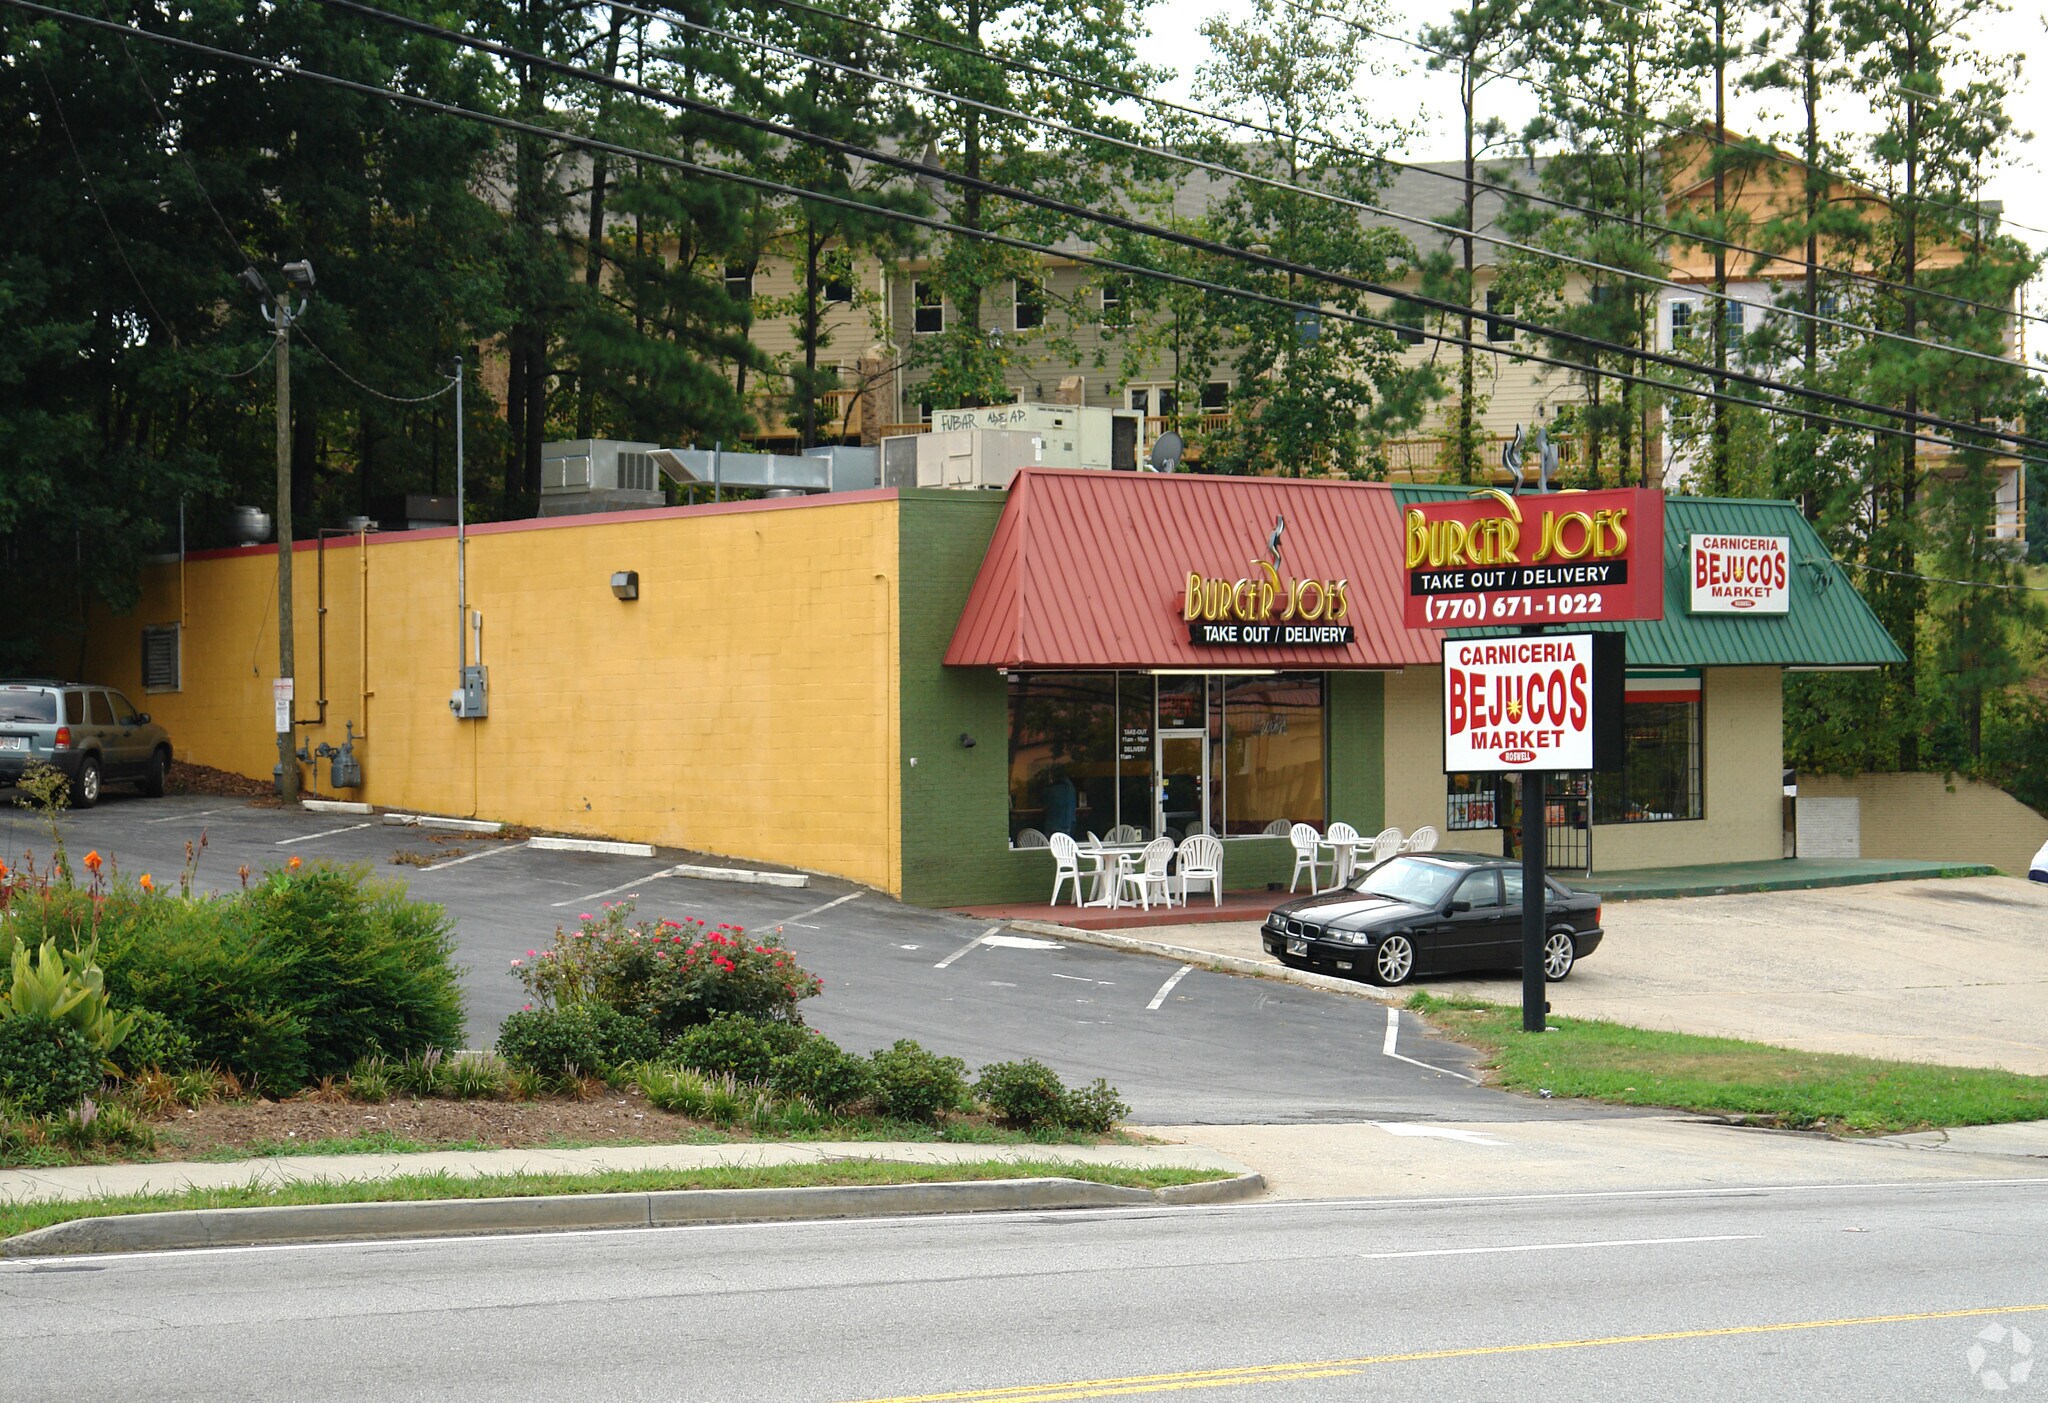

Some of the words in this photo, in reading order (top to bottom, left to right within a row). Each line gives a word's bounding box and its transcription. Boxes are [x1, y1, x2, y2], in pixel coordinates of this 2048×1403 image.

[941, 414, 978, 431] FUBAR
[1703, 537, 1778, 550] CARNICERIA
[1422, 574, 1464, 590] TAKE
[1471, 572, 1506, 587] OUT
[1512, 570, 1517, 585] /
[1523, 566, 1610, 585] DELIVERY
[1696, 549, 1785, 590] BEJUCOS
[1712, 587, 1772, 597] MARKET
[1425, 593, 1486, 622] (770)
[1492, 593, 1602, 616] 671-1022
[1204, 626, 1237, 642] TAKE
[1243, 626, 1270, 642] OUT
[1274, 626, 1280, 642] /
[1285, 627, 1347, 642] DELIVERY
[1459, 643, 1576, 666] CARNICERIA
[1450, 663, 1587, 736] BEJUCOS
[1471, 730, 1565, 749] MARKET
[1505, 752, 1531, 761] ROSWELL
